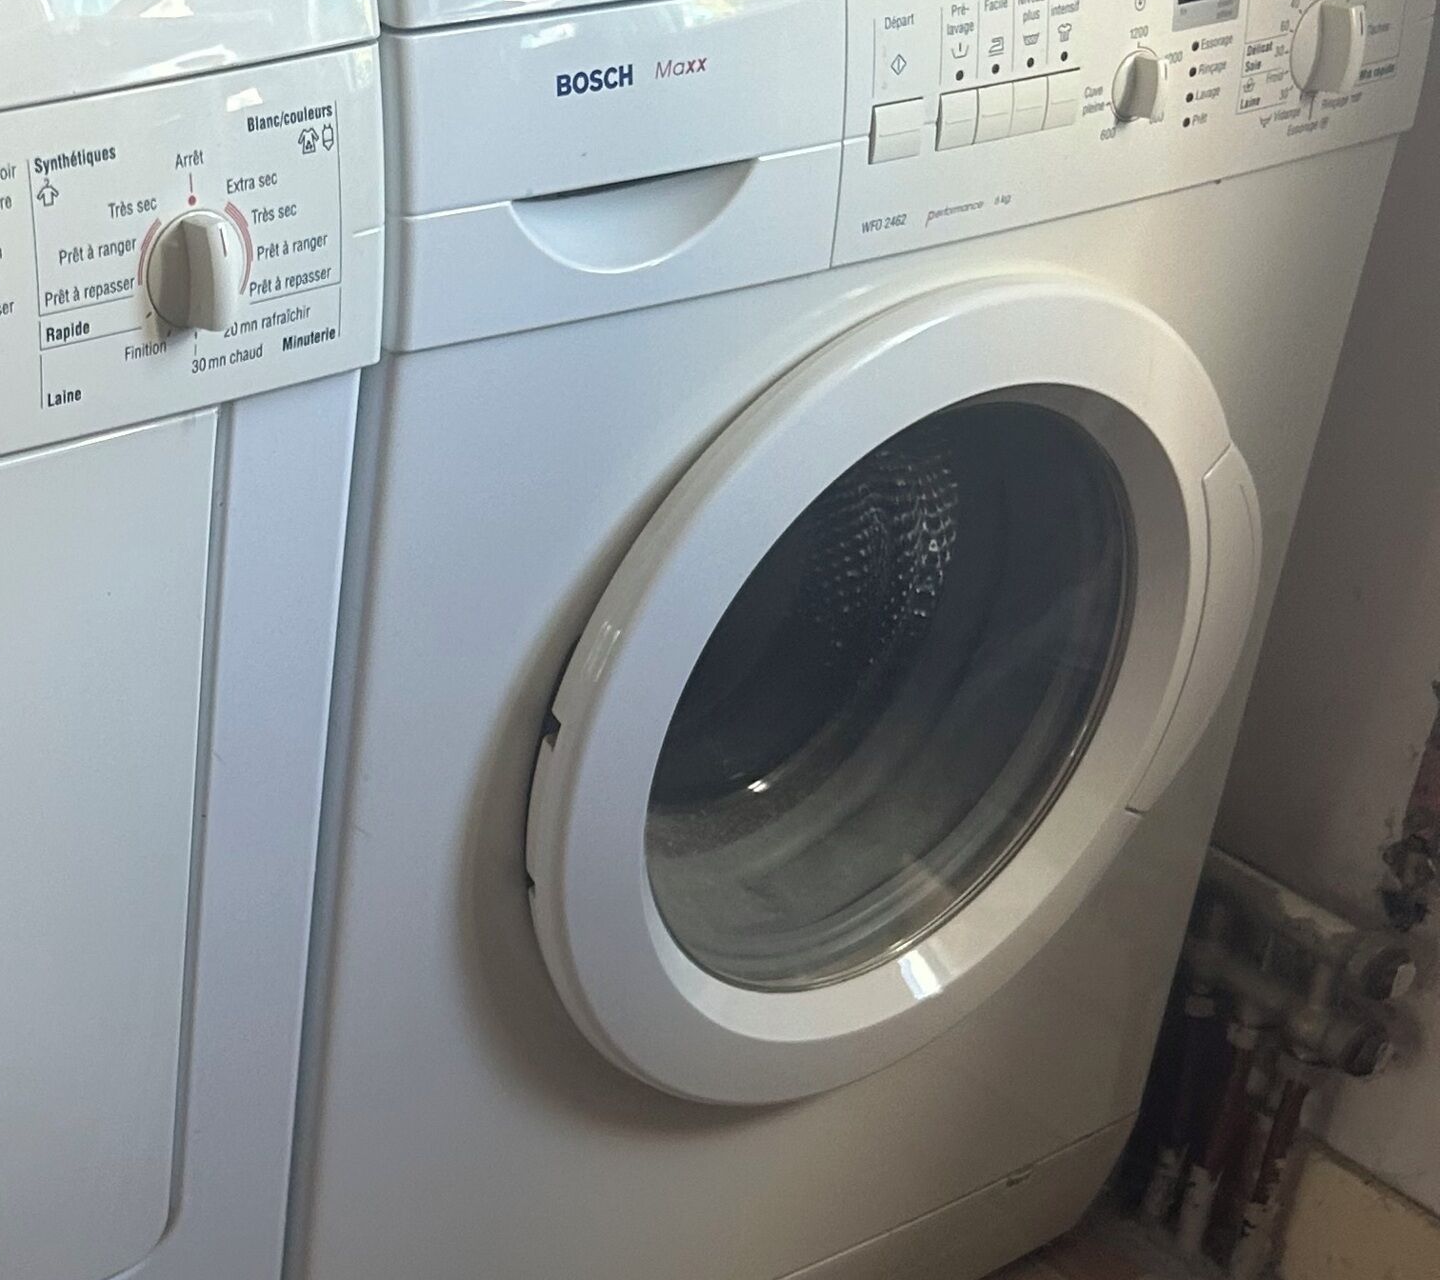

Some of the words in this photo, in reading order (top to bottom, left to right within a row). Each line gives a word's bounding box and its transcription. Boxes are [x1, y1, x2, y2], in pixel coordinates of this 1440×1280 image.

[1023, 8, 1040, 24] plus
[1051, 0, 1079, 17] intensif
[884, 13, 915, 31] Départ
[947, 21, 974, 37] lavage
[1130, 25, 1149, 39] 1200
[1201, 35, 1234, 50] Essorage
[556, 64, 634, 97] BOSCH
[654, 55, 707, 80] Maxx
[1084, 86, 1103, 99] Cuve
[1195, 86, 1221, 101] Lavage
[247, 104, 333, 133] Blanc/couleurs
[34, 146, 116, 176] Synthétiques
[175, 149, 204, 169] Arrêt
[226, 177, 255, 195] Extra
[259, 172, 278, 187] sec
[108, 202, 133, 219] Très
[137, 197, 157, 214] sec
[252, 206, 275, 225] Très
[278, 203, 297, 218] sec
[58, 245, 83, 266] Prêt
[87, 243, 94, 260] à
[98, 238, 137, 258] ranger
[257, 243, 279, 261] Prêt
[282, 240, 289, 255] à
[293, 234, 328, 253] ranger
[45, 288, 69, 308] Prêt
[73, 285, 80, 302] à
[84, 276, 136, 300] repasser
[249, 277, 272, 297] Prêt
[275, 276, 282, 291] à
[285, 266, 332, 288] repasser
[240, 319, 258, 335] mn
[261, 305, 311, 330] rafraîchir
[46, 322, 90, 343] Rapide
[282, 326, 336, 353] Minuterie
[125, 340, 167, 361] Finition
[191, 356, 207, 374] 30
[208, 356, 226, 371] mn
[229, 344, 263, 365] chaud
[47, 389, 82, 408] Laine
